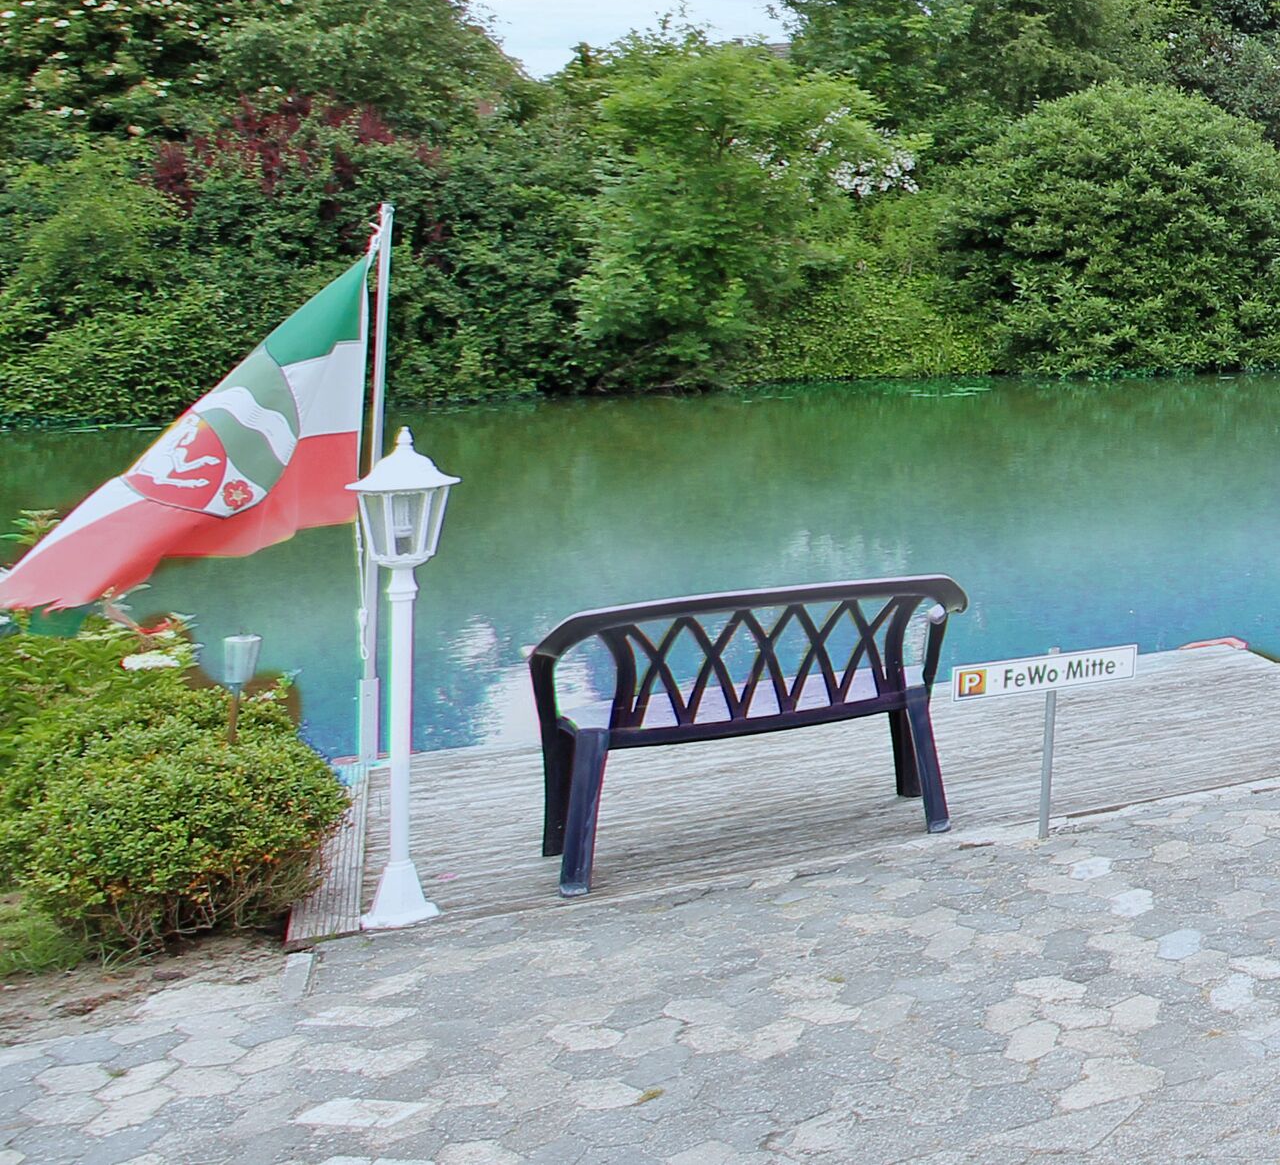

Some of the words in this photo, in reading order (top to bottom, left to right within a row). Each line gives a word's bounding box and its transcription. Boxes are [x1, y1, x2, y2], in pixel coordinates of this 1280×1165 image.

[962, 673, 982, 694] P
[1003, 664, 1058, 689] FeWo
[1066, 658, 1116, 680] Mitte
